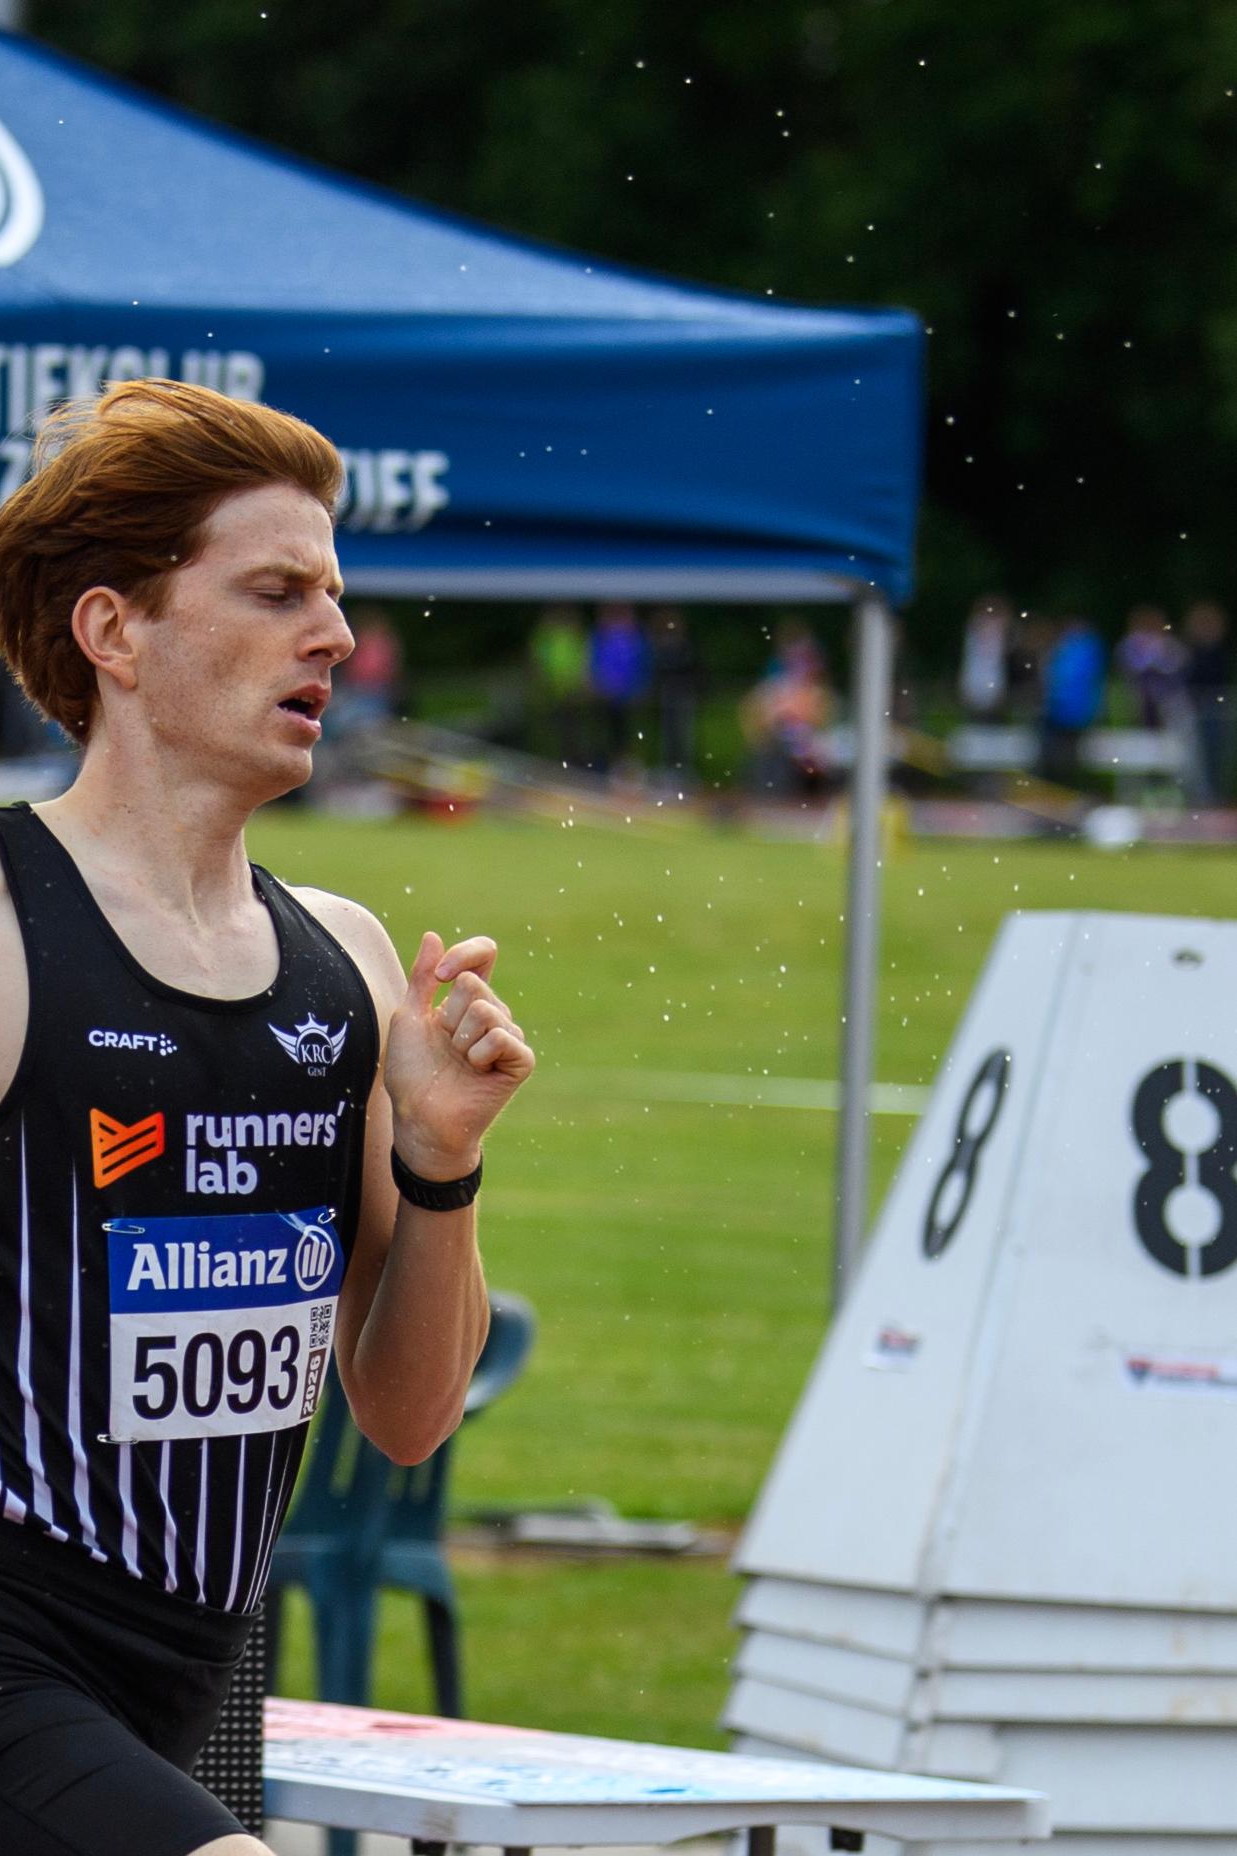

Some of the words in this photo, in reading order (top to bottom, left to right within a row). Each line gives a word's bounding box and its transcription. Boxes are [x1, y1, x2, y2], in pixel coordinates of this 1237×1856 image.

[89, 1030, 157, 1051] CRAFT
[301, 1044, 331, 1064] KRC
[186, 1149, 258, 1194] lab
[921, 1046, 1011, 1261] 8
[1132, 1056, 1237, 1280] 8
[127, 1241, 288, 1290] Allianz
[132, 1325, 300, 1420] 5093
[302, 1354, 321, 1415] 2026
